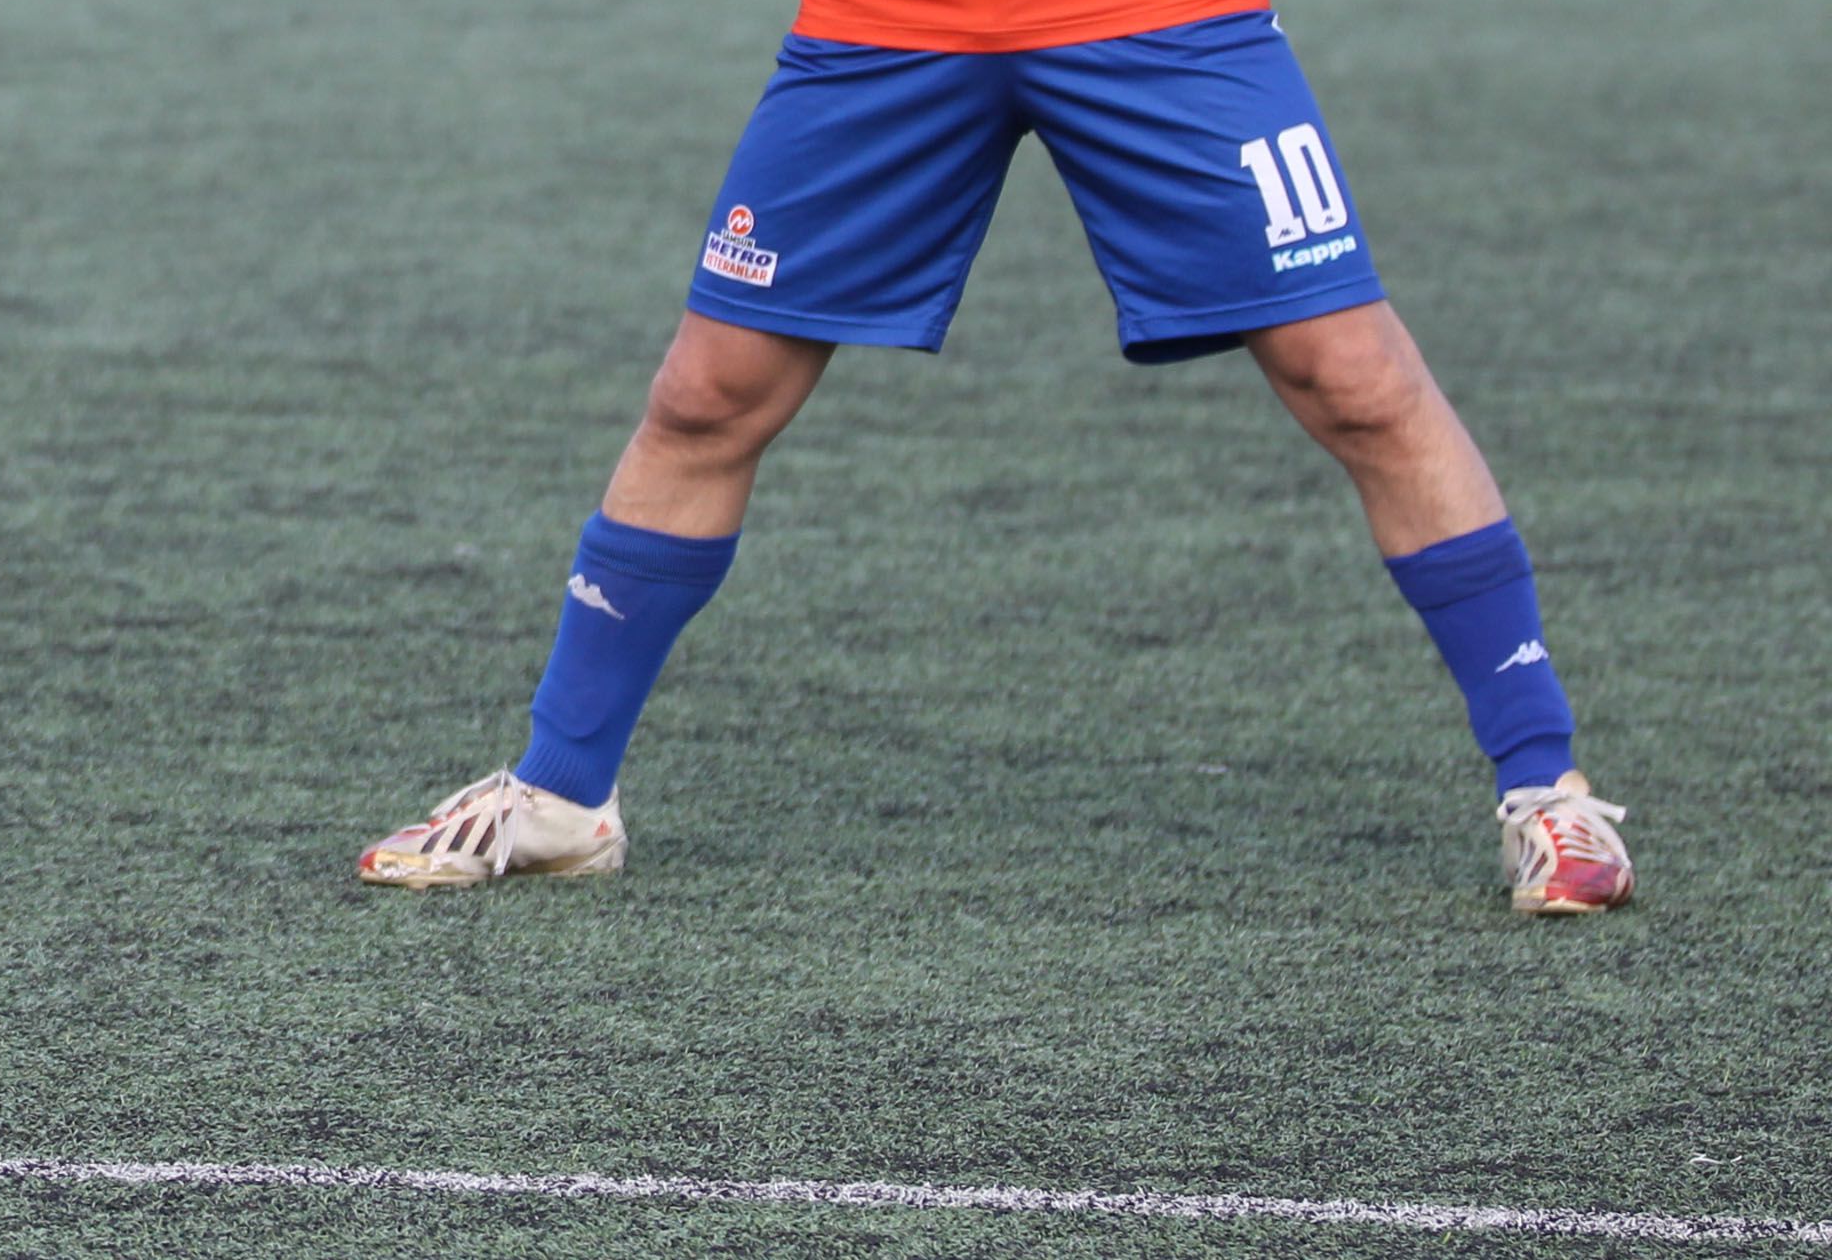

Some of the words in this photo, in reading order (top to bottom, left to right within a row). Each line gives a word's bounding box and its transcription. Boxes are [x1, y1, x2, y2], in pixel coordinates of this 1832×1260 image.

[1240, 122, 1348, 249] 10
[708, 236, 773, 267] METRO
[1271, 234, 1358, 273] Kappa
